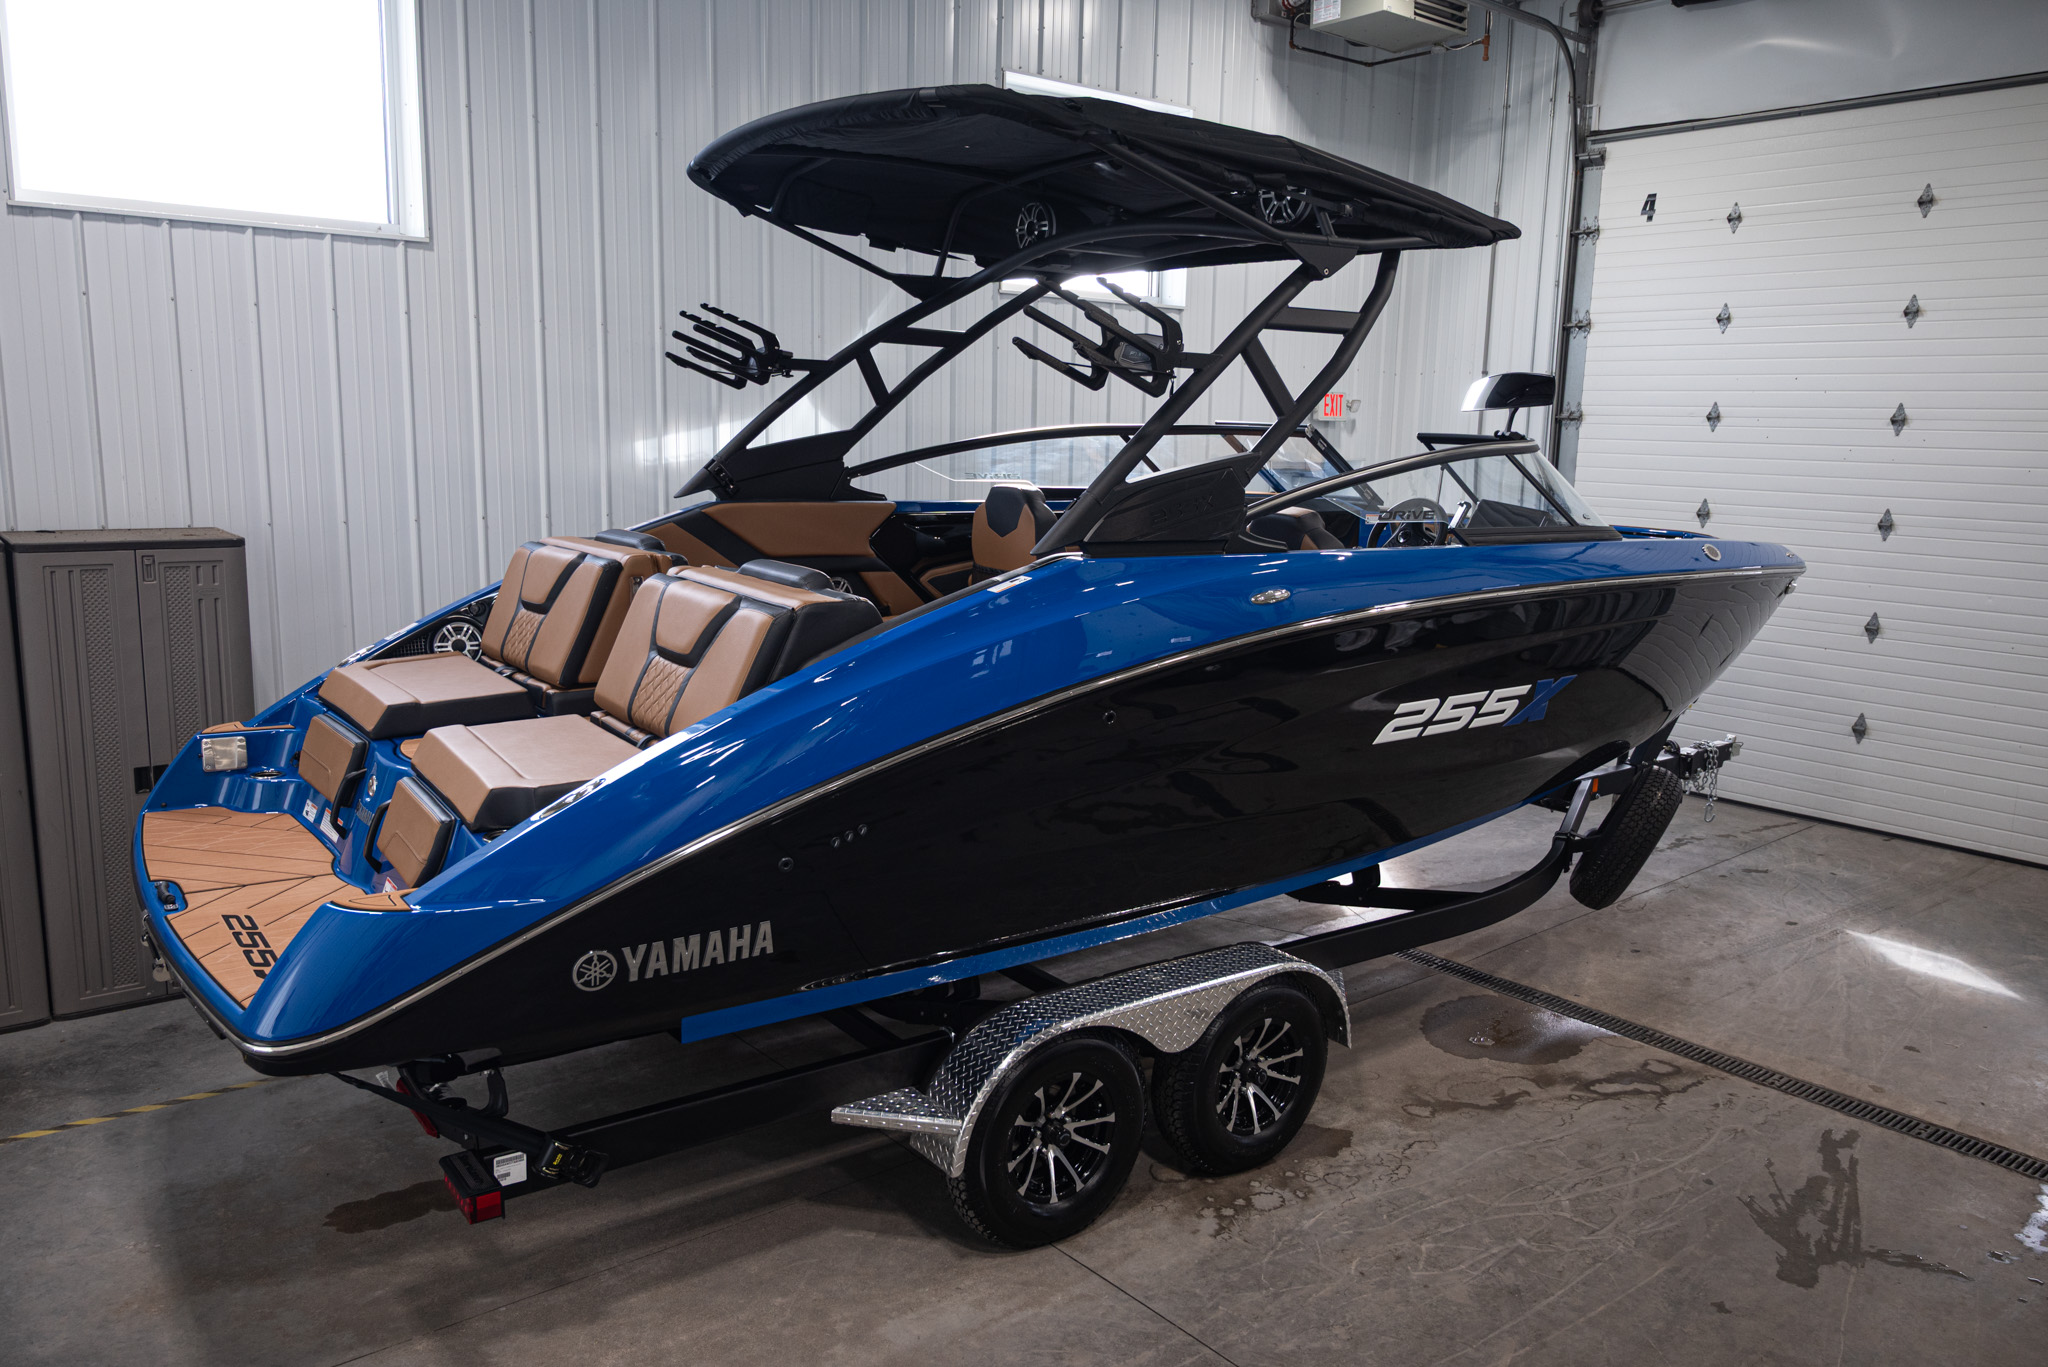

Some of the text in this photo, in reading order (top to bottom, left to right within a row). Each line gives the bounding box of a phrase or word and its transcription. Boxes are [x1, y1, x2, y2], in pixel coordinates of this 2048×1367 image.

[1640, 193, 1657, 222] 4
[1323, 393, 1344, 417] EXIT
[1372, 674, 1578, 745] 255X
[221, 914, 279, 980] 255
[621, 920, 774, 982] YAMAHA
